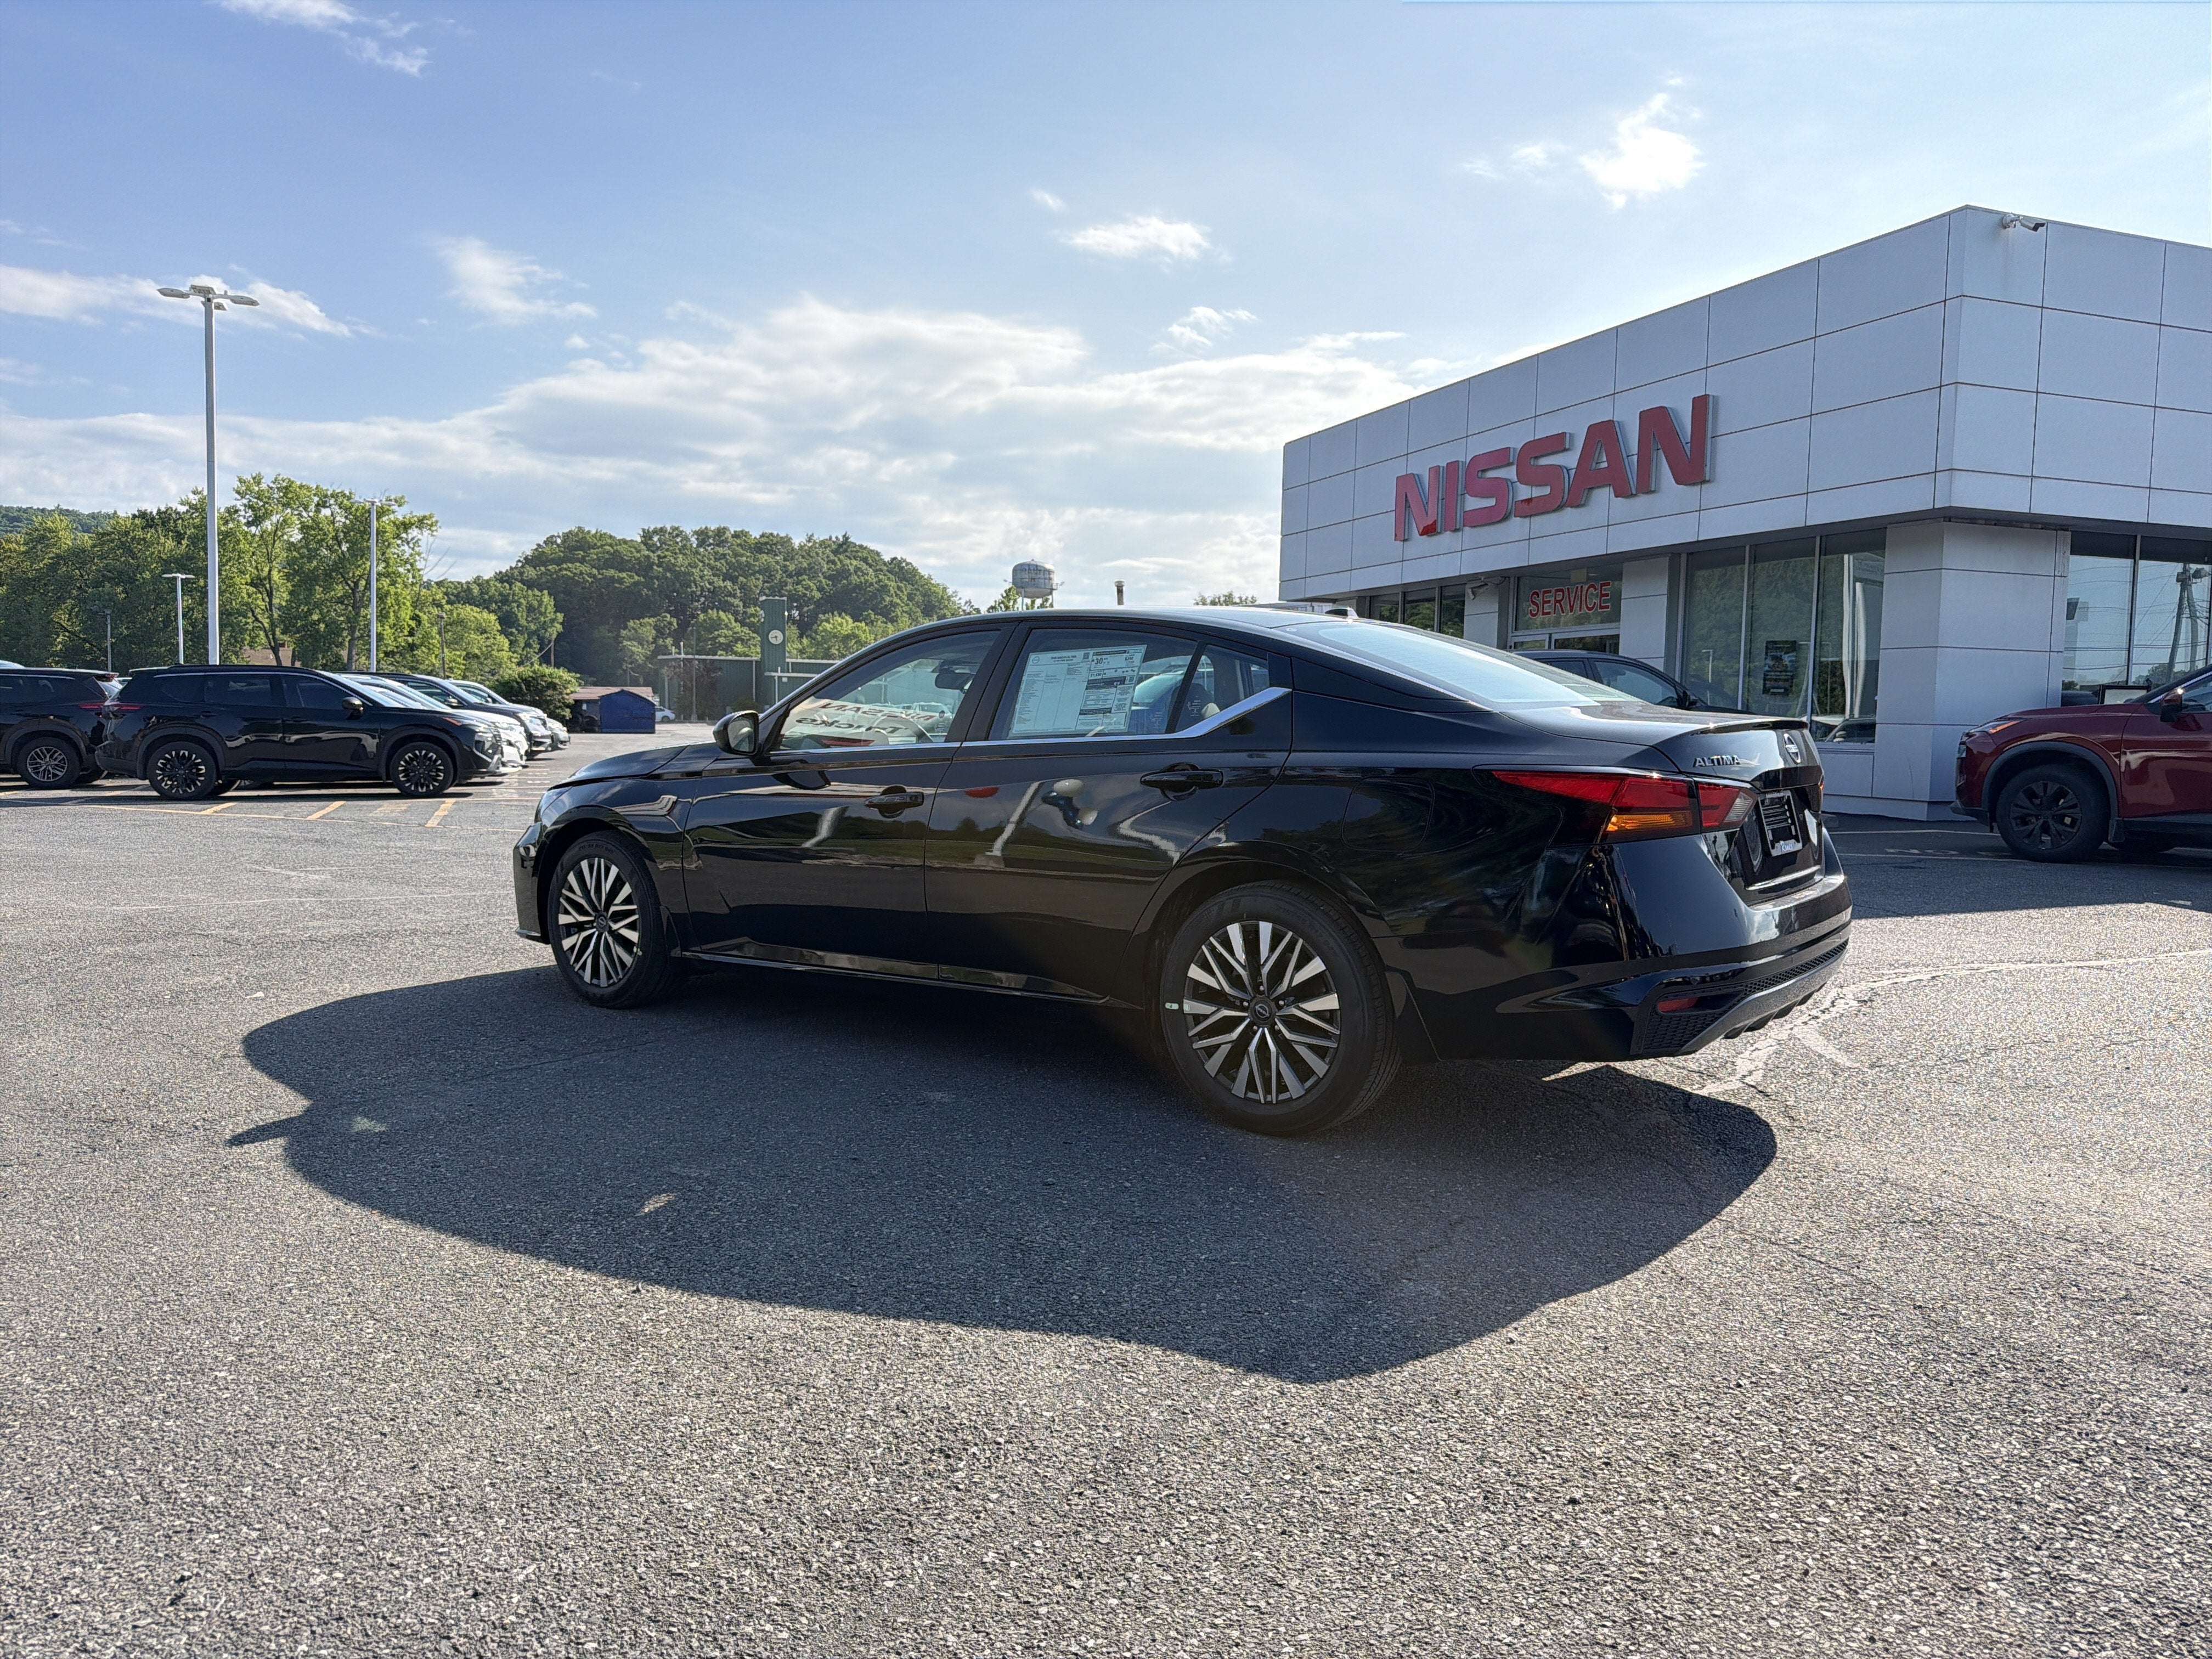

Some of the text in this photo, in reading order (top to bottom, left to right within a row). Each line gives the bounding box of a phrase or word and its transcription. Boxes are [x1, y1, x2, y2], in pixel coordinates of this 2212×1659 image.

[1395, 394, 1713, 541] NISSAN
[1528, 580, 1611, 619] SERVICE
[1694, 755, 1741, 767] ALTIMA
